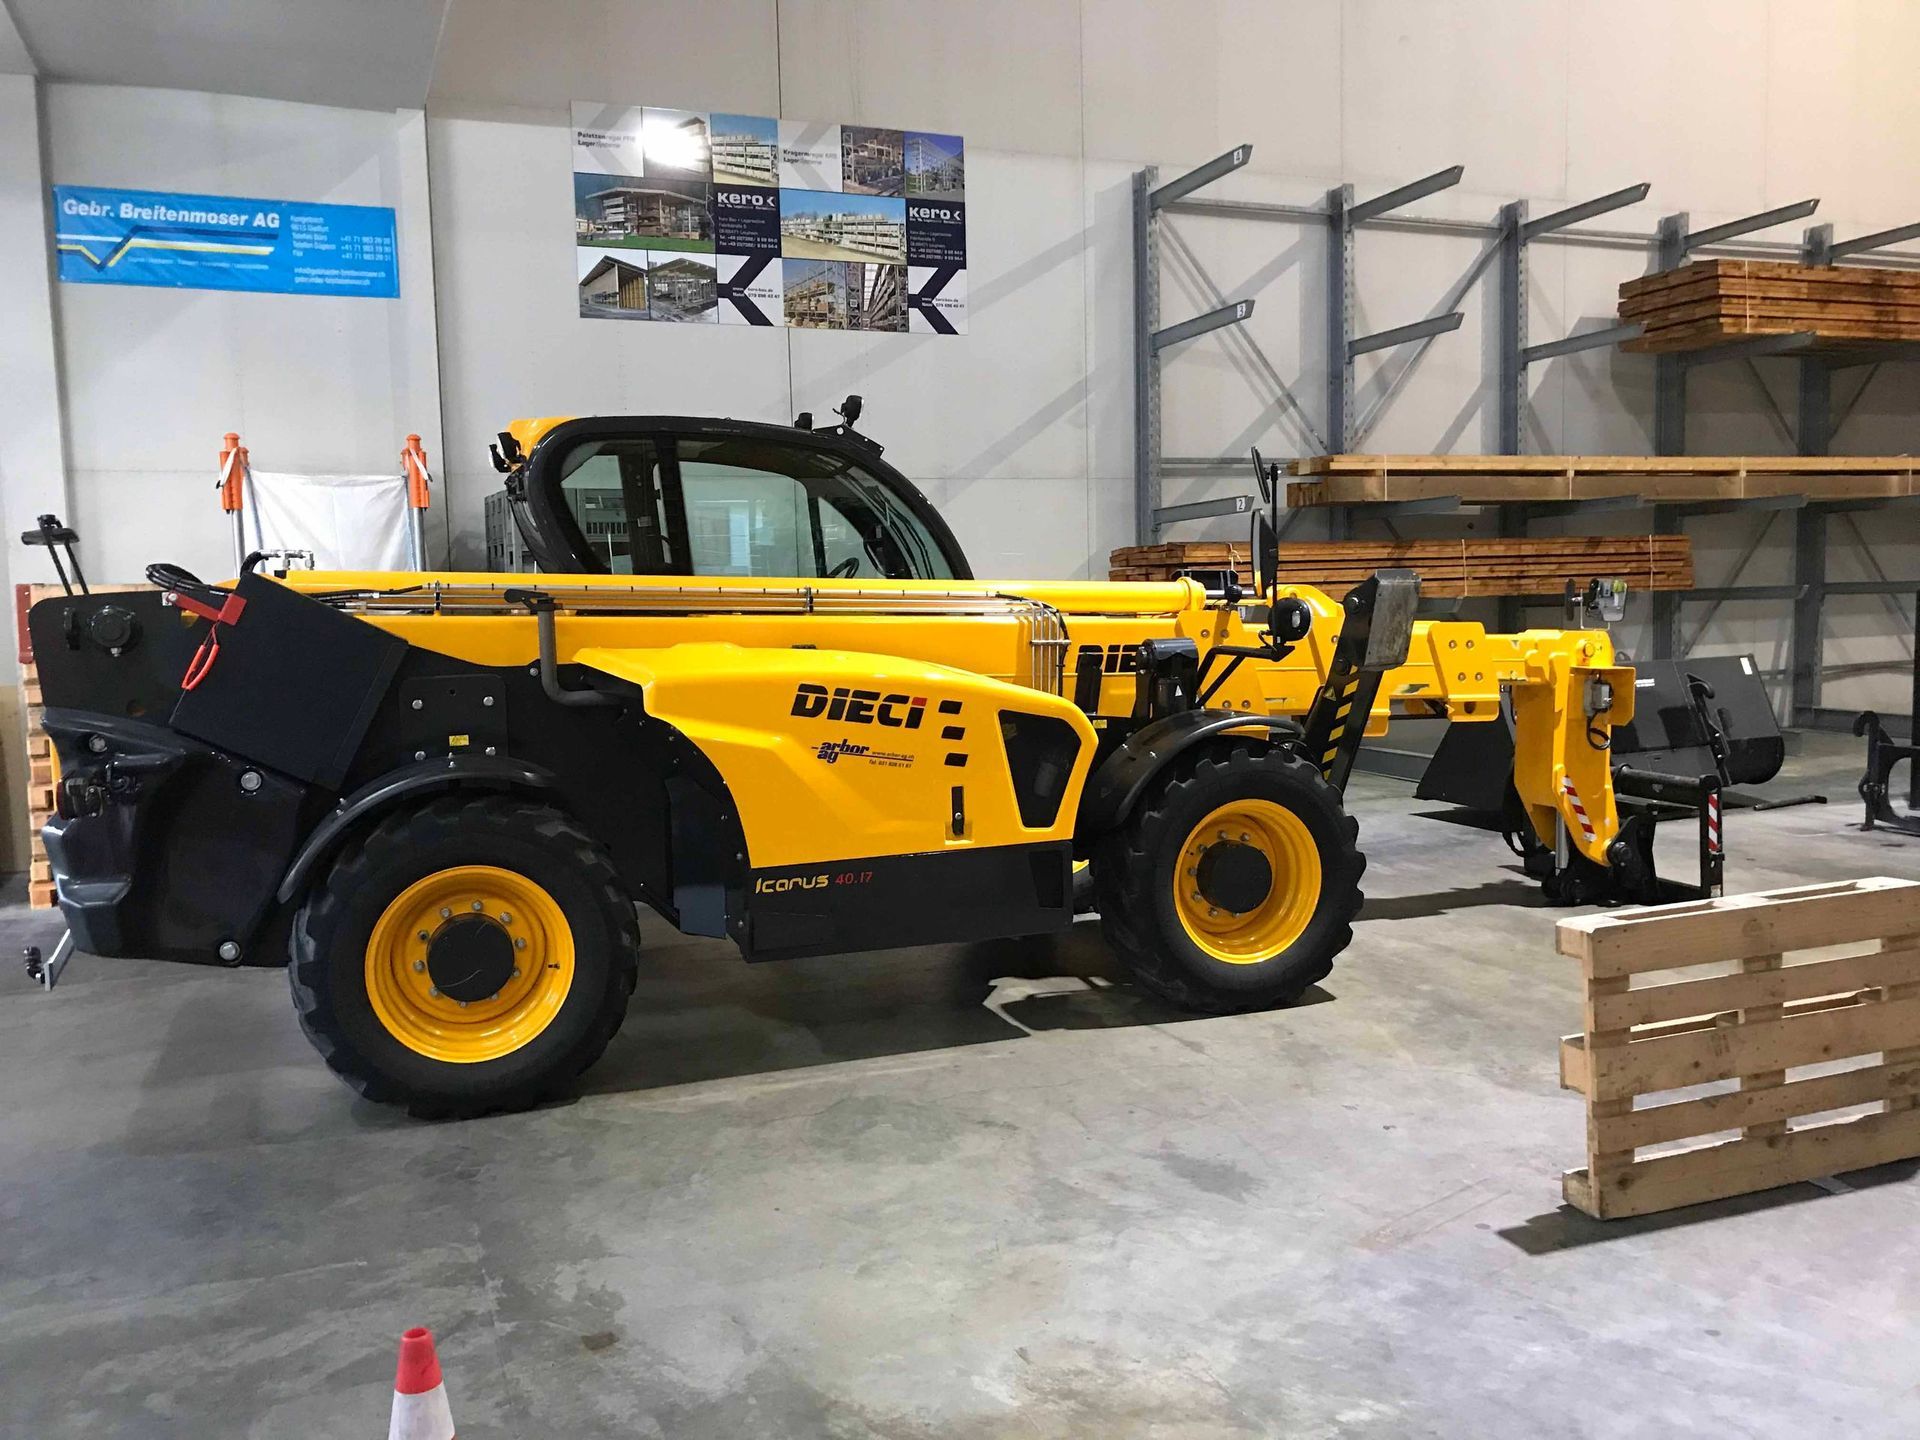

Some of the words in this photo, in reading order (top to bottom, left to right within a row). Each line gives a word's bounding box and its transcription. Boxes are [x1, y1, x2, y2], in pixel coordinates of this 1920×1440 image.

[63, 199, 115, 218] Gebr.
[119, 202, 248, 227] Breitenmoser
[252, 213, 279, 228] AG
[790, 683, 928, 730] DIECI
[816, 750, 840, 764] ag
[820, 738, 870, 754] arbor
[755, 874, 830, 894] Icarus
[834, 871, 873, 885] 40.17
